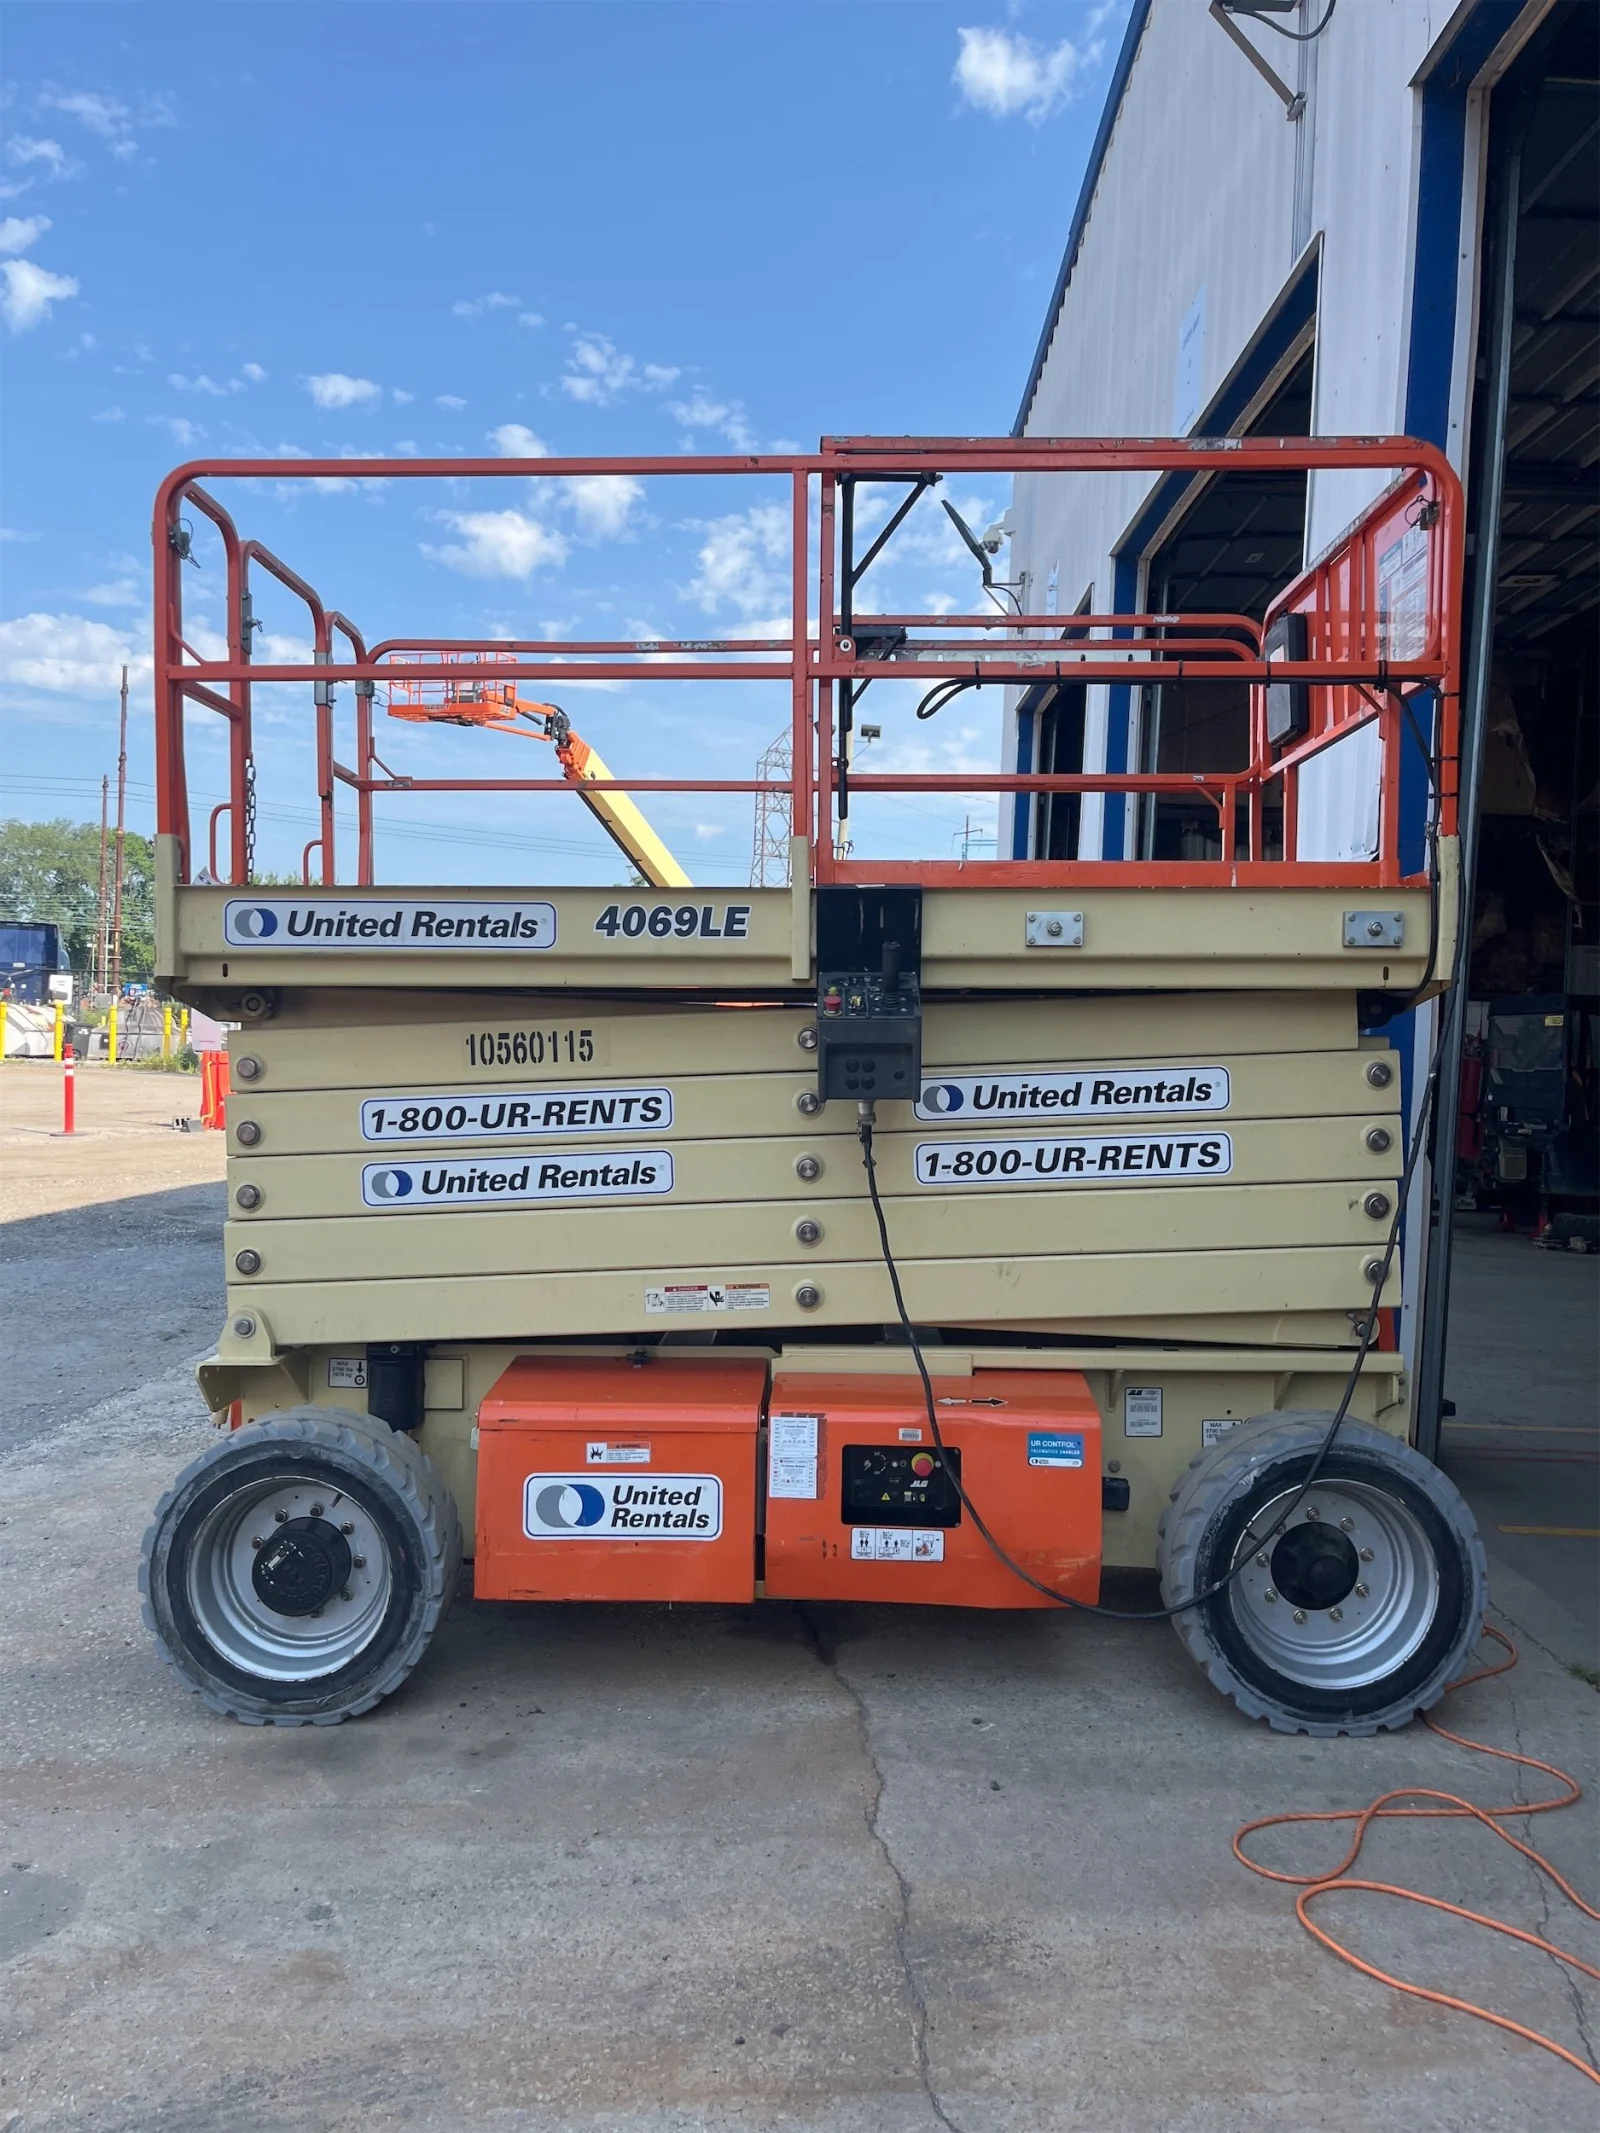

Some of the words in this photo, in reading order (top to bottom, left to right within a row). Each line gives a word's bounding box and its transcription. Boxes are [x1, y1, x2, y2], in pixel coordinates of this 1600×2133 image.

[287, 910, 404, 938] United
[410, 910, 539, 939] Rentals
[595, 905, 750, 938] 4069LE
[465, 1029, 594, 1066] 10560115
[972, 1081, 1083, 1110] United
[1090, 1076, 1213, 1106] Rentals
[371, 1096, 663, 1133] 1-800-UR-RENTS
[925, 1141, 1221, 1178] 1-800-UR-RENTS
[421, 1165, 530, 1195] United
[537, 1160, 657, 1189] Rentals
[1042, 1440, 1076, 1448] CONTROL
[612, 1485, 703, 1506] United
[910, 1480, 929, 1488] JLG
[610, 1507, 710, 1529] Rentals
